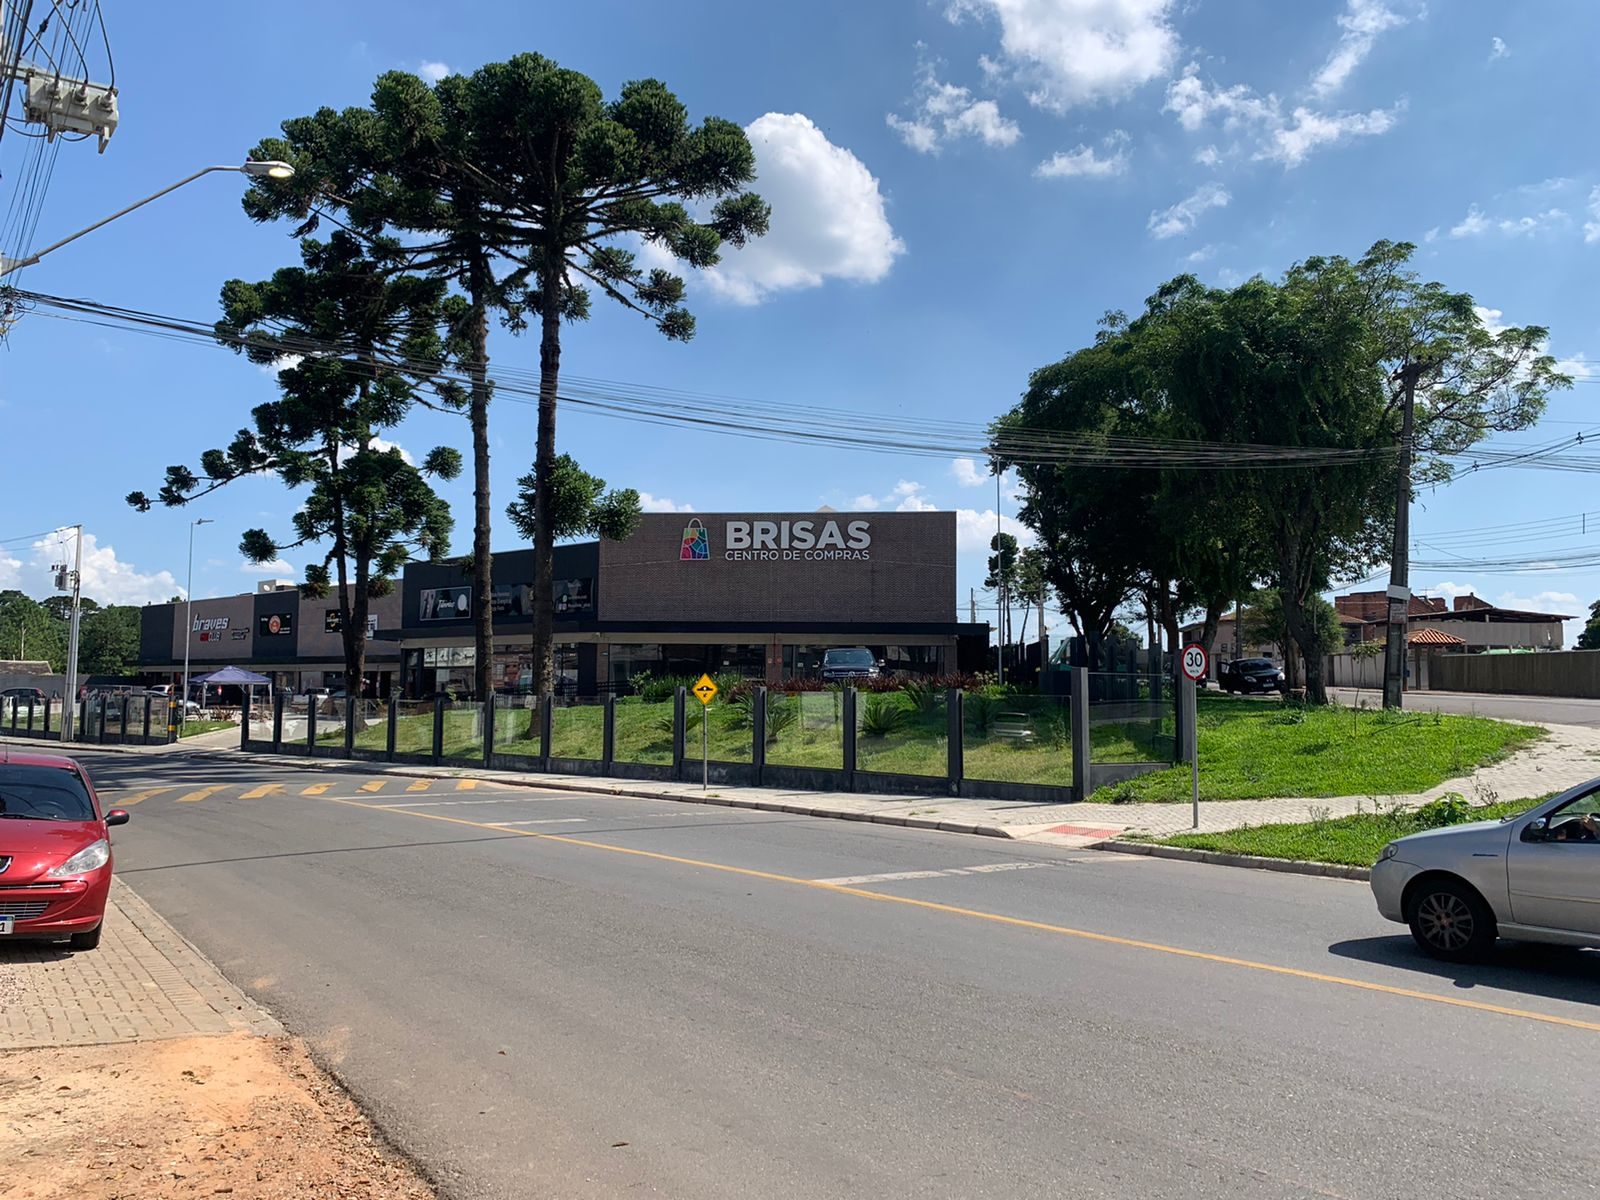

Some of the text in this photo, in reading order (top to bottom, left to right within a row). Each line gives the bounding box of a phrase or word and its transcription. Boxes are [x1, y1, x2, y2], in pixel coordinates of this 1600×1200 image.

[726, 520, 871, 550] BRISAS
[725, 550, 870, 561] CENTRO DE COMPRAS
[192, 613, 229, 632] braves
[1186, 651, 1203, 667] 30
